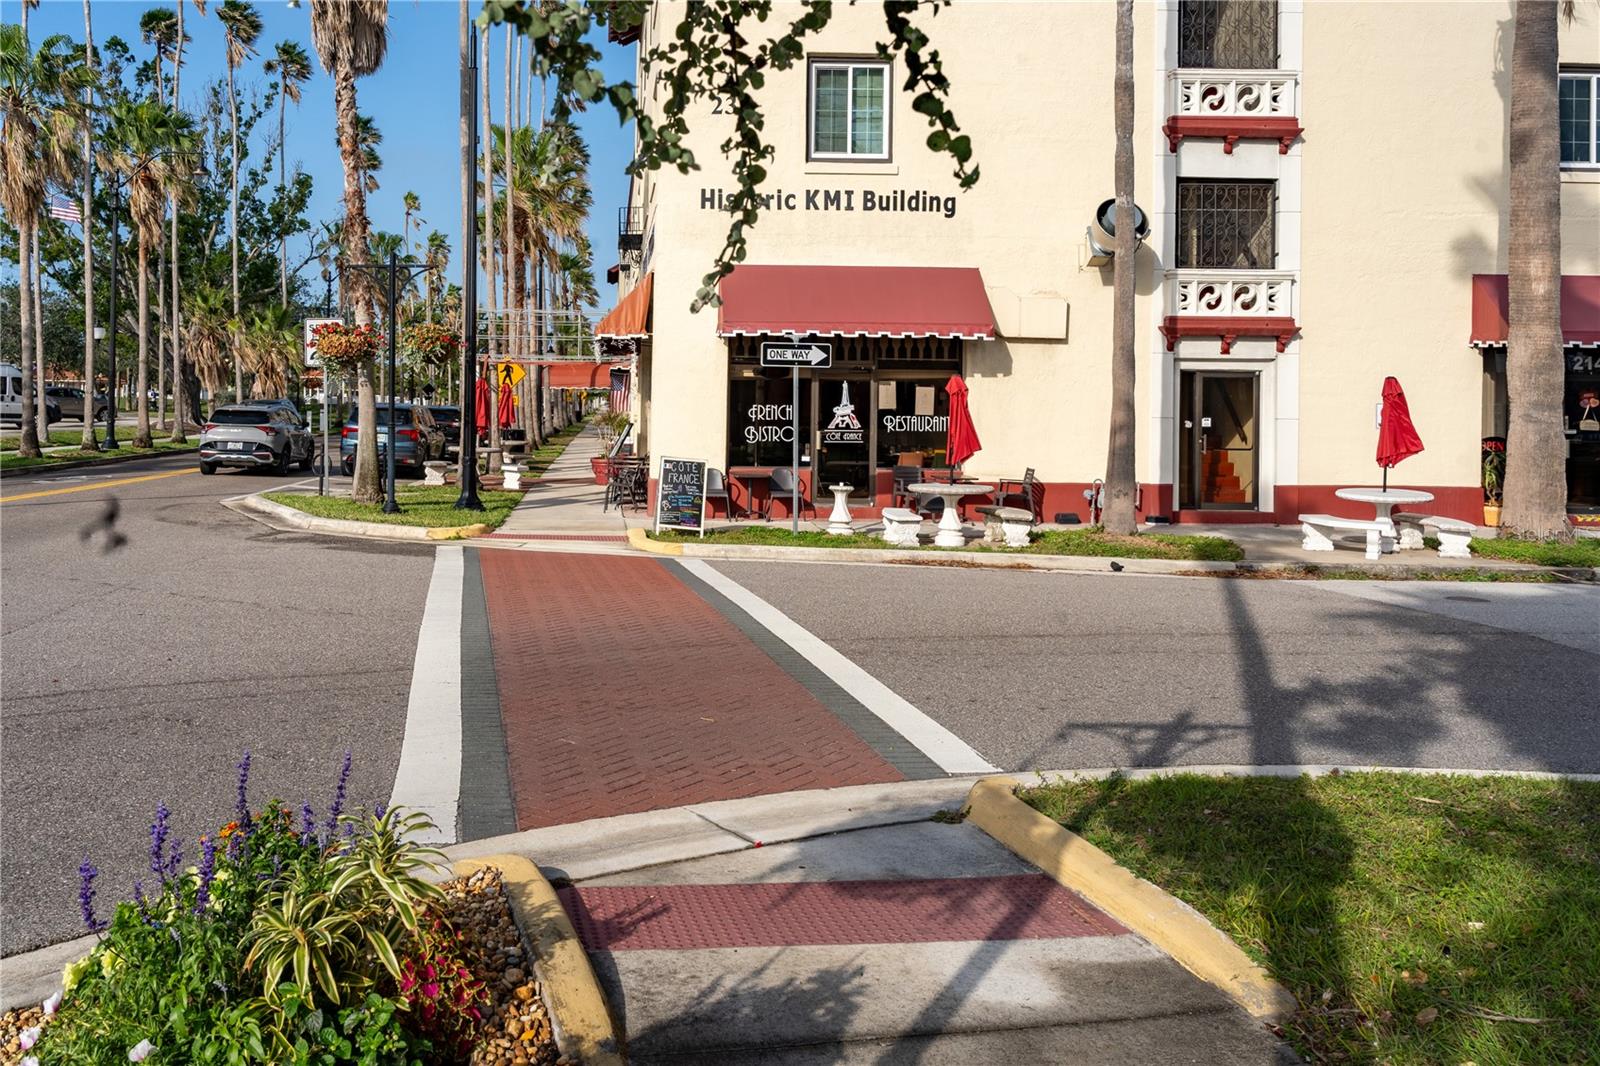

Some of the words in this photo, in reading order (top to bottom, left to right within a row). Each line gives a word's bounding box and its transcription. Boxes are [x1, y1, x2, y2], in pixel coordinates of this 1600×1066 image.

[701, 188, 796, 211] Hisric
[805, 189, 854, 211] KMI
[862, 190, 956, 218] Building
[769, 349, 788, 359] ONE
[791, 350, 811, 360] WAY
[748, 404, 793, 422] FRENCH
[744, 425, 796, 443] BISTRO
[668, 472, 700, 484] FRANCE
